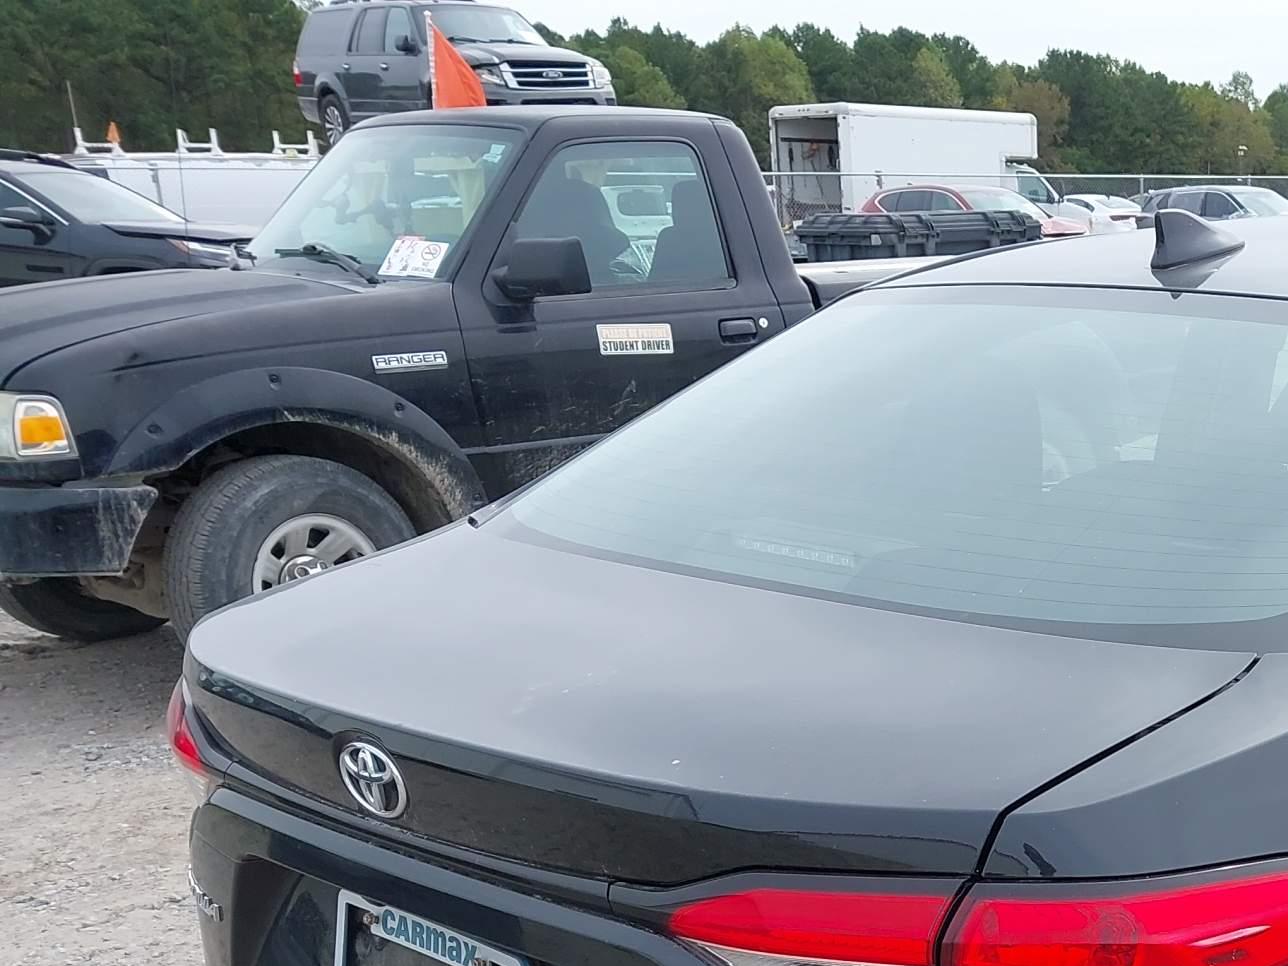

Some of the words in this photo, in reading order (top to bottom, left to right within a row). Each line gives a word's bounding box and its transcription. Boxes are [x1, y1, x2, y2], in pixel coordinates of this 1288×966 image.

[602, 340, 639, 352] STUDENT
[641, 339, 671, 351] DRIVER
[374, 353, 446, 367] RANGER
